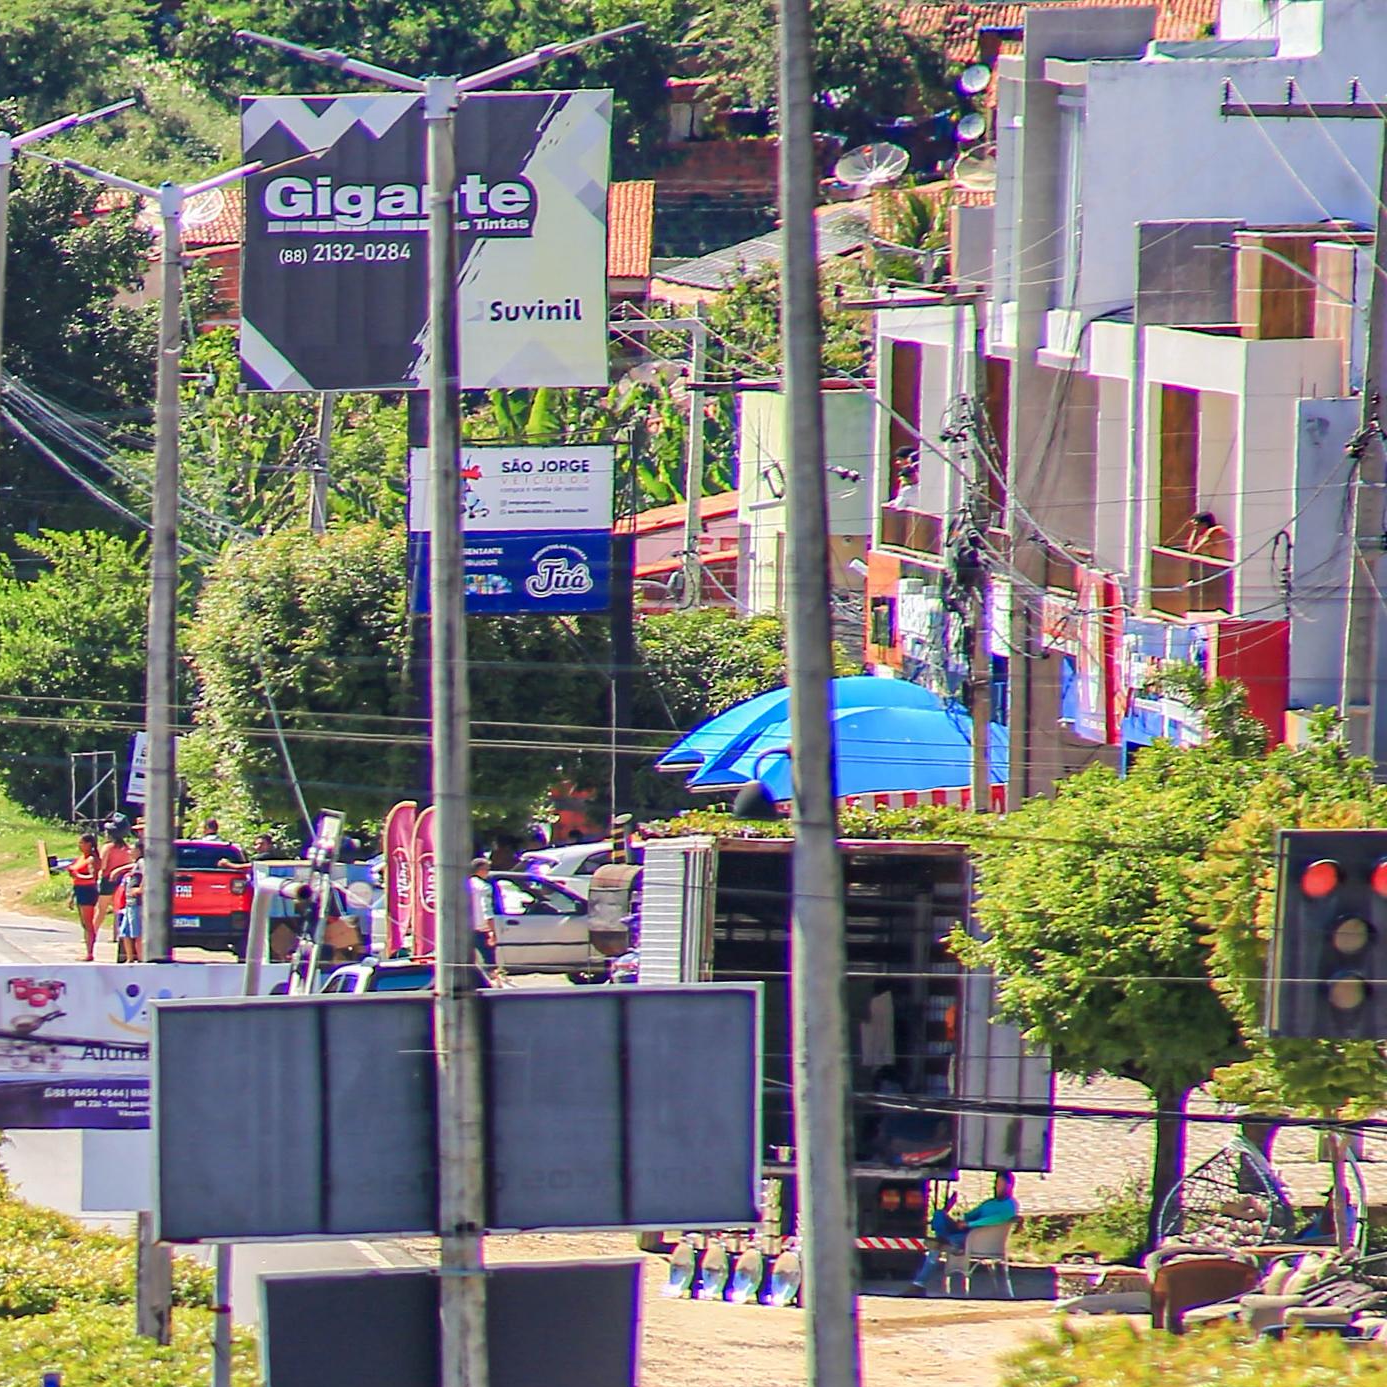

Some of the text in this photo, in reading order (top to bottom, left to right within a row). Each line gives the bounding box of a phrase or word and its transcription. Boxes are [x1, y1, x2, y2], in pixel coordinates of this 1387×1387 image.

[474, 217, 530, 231] Tintas
[279, 243, 412, 265] (88) 2132-0284
[489, 298, 582, 321] Suvinil
[501, 458, 591, 474] SÃO JORGE
[528, 560, 591, 596] Juá
